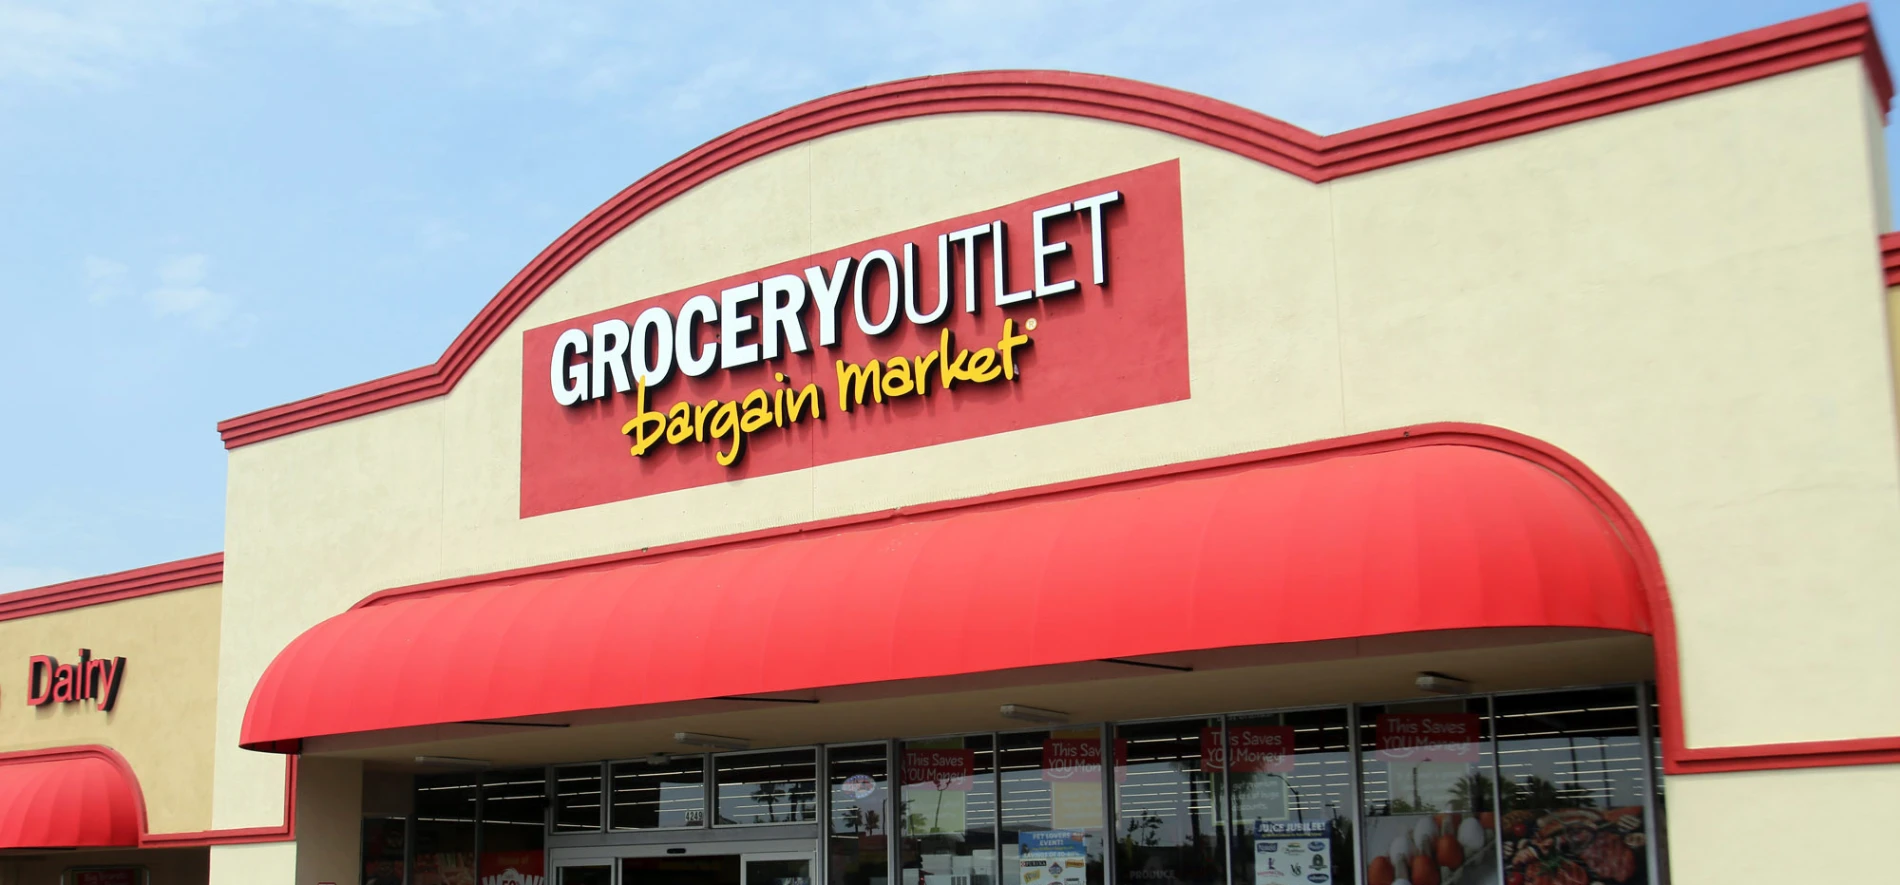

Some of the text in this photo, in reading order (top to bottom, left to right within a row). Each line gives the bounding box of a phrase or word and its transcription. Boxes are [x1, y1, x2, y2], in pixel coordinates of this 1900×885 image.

[621, 374, 820, 466] bargain
[27, 648, 126, 713] Dairy
[1386, 718, 1467, 735] This Saves
[1210, 730, 1283, 747] Tis Saves
[1382, 736, 1472, 756] YOU Money!
[1051, 741, 1078, 757] This
[1236, 747, 1287, 764] Money!
[906, 752, 965, 767] This Saves
[1048, 758, 1120, 774] YOU Mon!
[927, 768, 968, 785] Money!
[683, 810, 703, 822] 4249
[1286, 821, 1326, 832] JUBILEE!
[1129, 869, 1176, 880] PRODUCE
